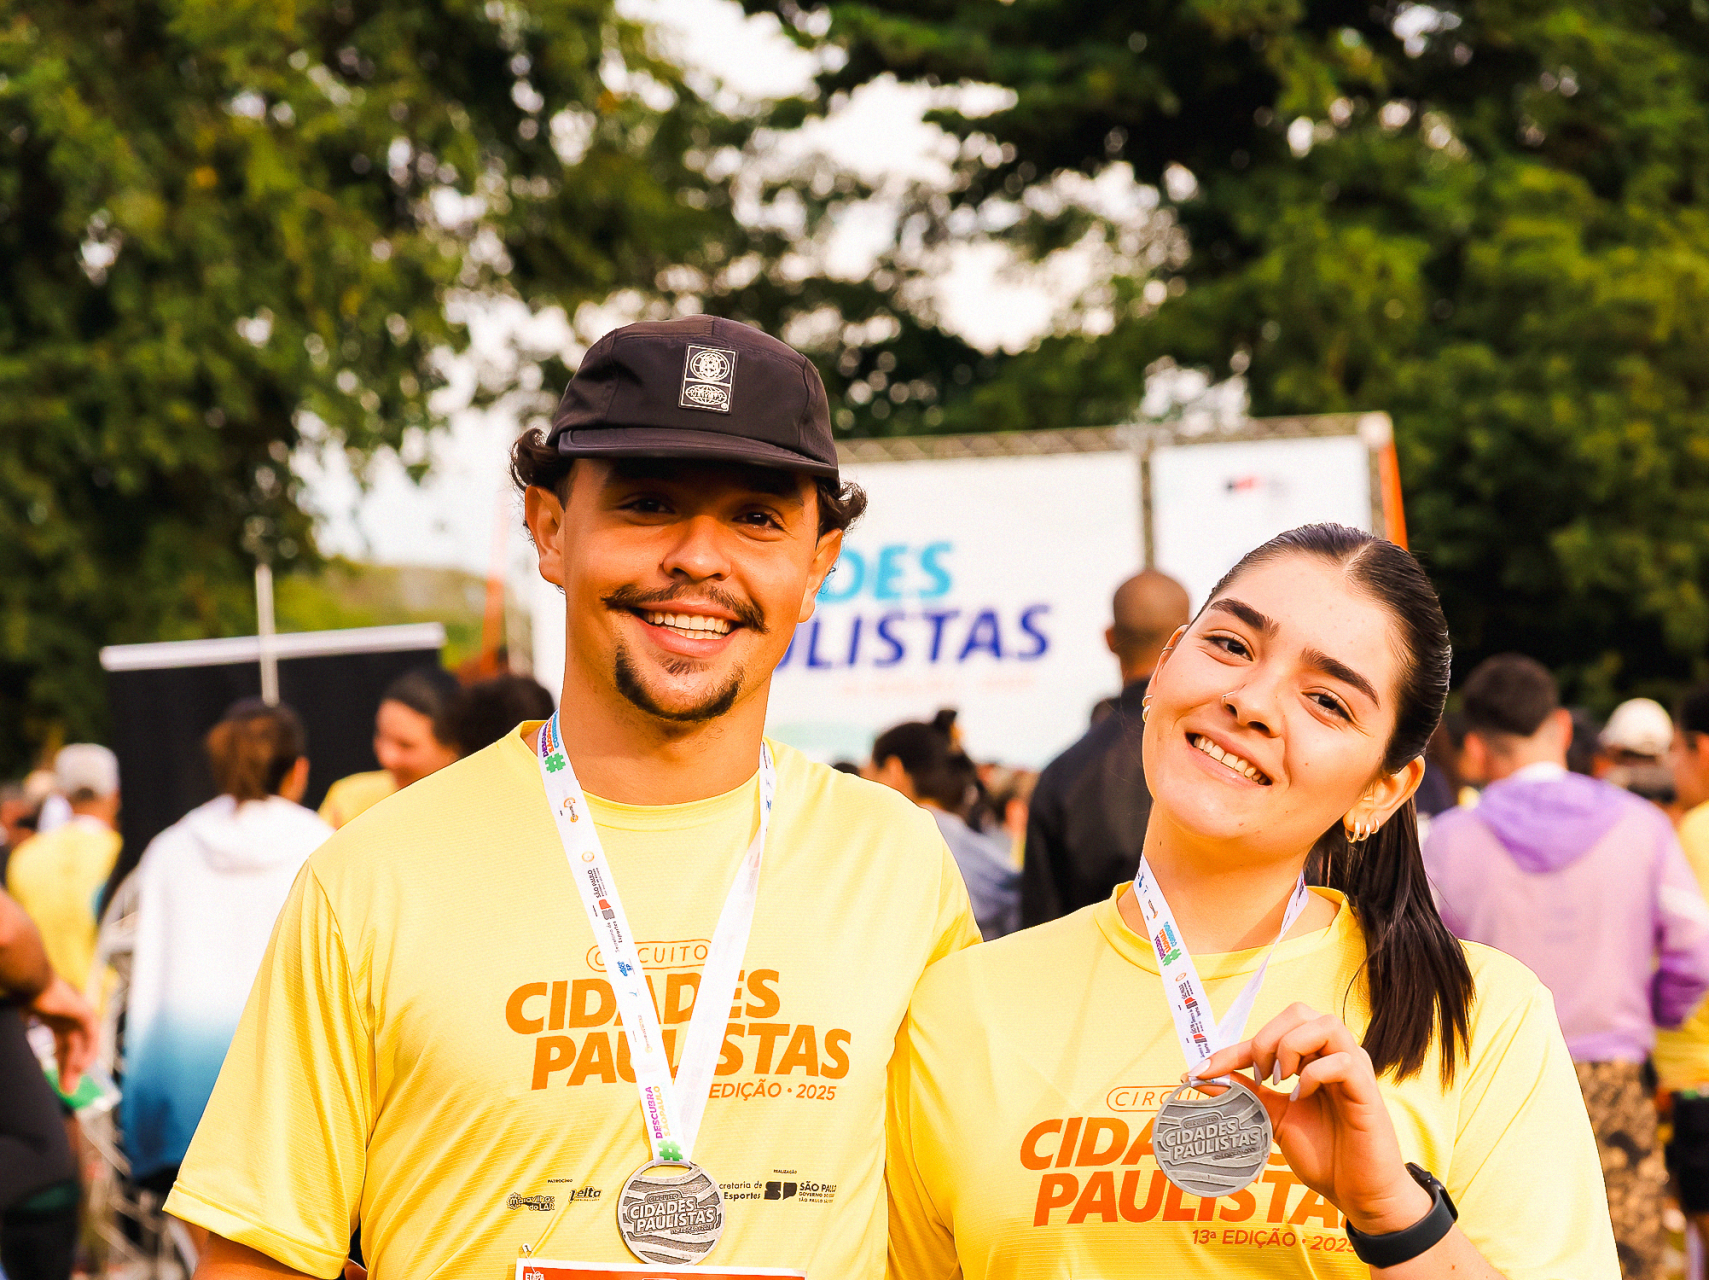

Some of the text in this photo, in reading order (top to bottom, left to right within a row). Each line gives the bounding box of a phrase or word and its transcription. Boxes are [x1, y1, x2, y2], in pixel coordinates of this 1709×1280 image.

[773, 604, 1052, 672] LISTAS
[594, 944, 708, 966] CCUITO
[505, 968, 780, 1035] CIDDS
[531, 1022, 852, 1090] PAUSTAS
[709, 1079, 837, 1102] EDIÇÃO 2025
[645, 1086, 663, 1139] DESCUBRA
[1165, 1120, 1237, 1147] CIDADES
[1173, 1129, 1260, 1160] PAULISTAS
[718, 1180, 763, 1189] cretaria de
[799, 1180, 820, 1192] SÃO
[723, 1191, 761, 1202] Esportes
[1033, 1170, 1348, 1228] PAULISTA
[630, 1199, 694, 1219] CIDADES
[636, 1209, 714, 1232] PAULISTAS
[1222, 1228, 1296, 1248] EDIÇÃO
